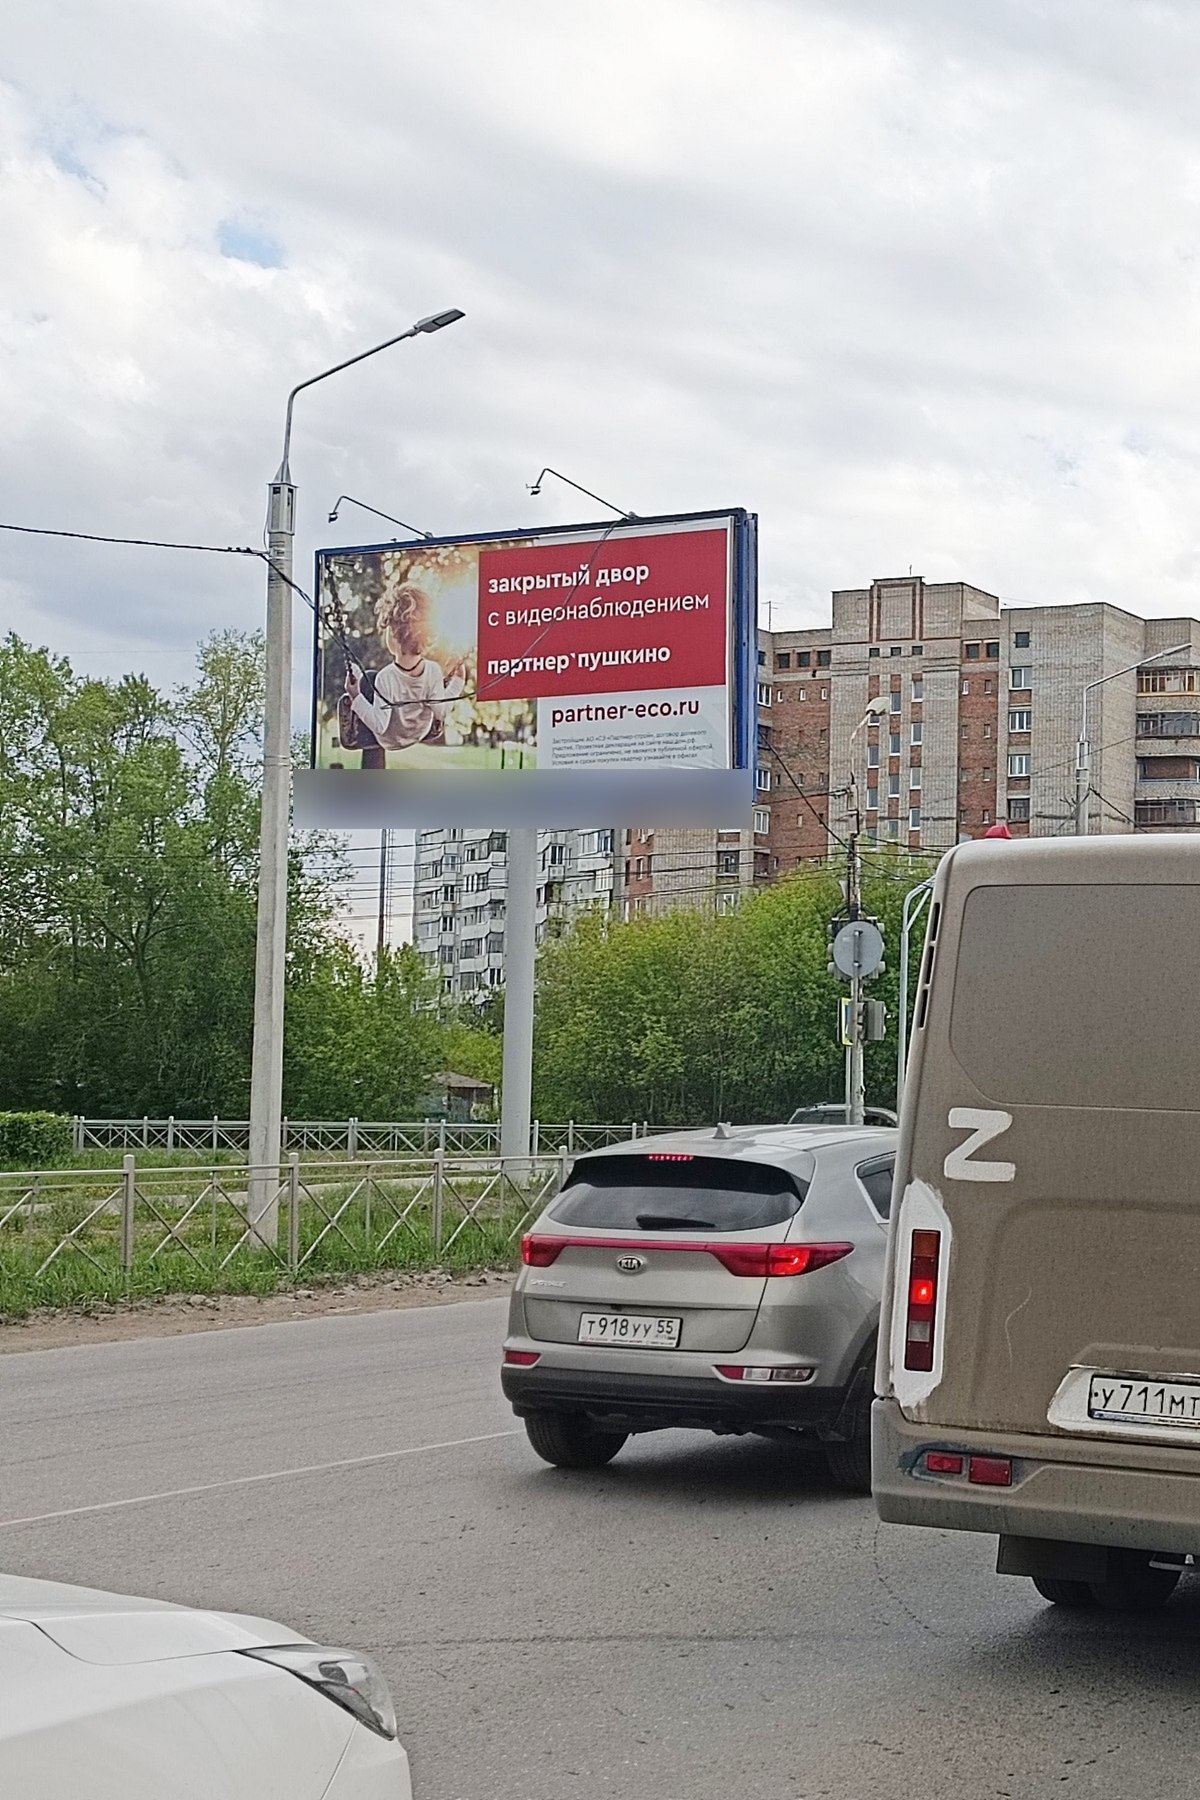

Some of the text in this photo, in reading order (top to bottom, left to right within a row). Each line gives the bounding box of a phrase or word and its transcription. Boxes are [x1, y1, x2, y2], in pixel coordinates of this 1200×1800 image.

[488, 564, 650, 594] закрытый двор
[488, 593, 709, 627] с видеонаблюдением
[487, 646, 671, 678] партнер пушкино
[552, 700, 699, 728] partner-eco.ru
[944, 1107, 1017, 1183] Z
[621, 1260, 638, 1269] KIA
[657, 1320, 674, 1334] 55
[1102, 1384, 1200, 1416] У711МТ
